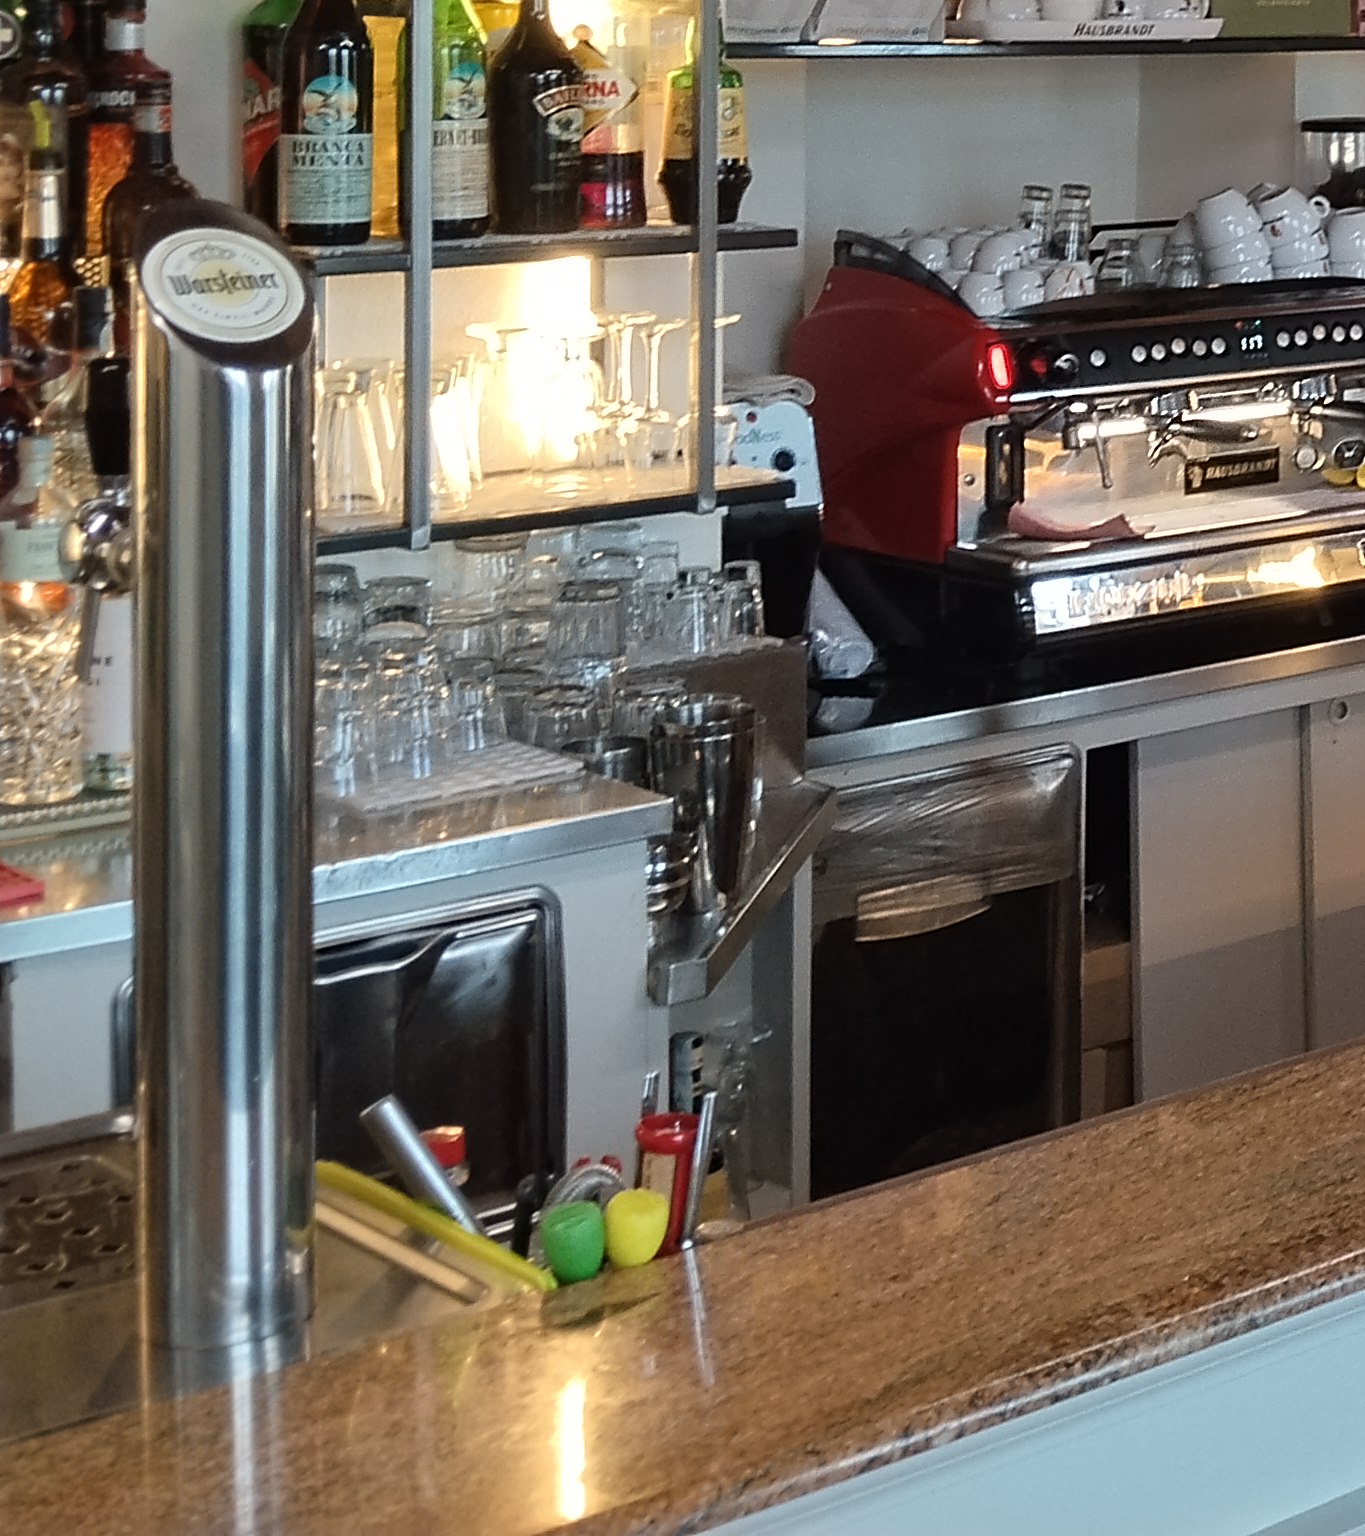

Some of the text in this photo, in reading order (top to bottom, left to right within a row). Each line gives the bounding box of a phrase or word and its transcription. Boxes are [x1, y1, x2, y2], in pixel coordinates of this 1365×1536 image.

[1072, 22, 1157, 38] HAUSBRANDT
[584, 80, 621, 98] RNA
[291, 139, 366, 154] BRANCA
[291, 153, 366, 167] MENTA
[167, 268, 280, 297] Warsteiner
